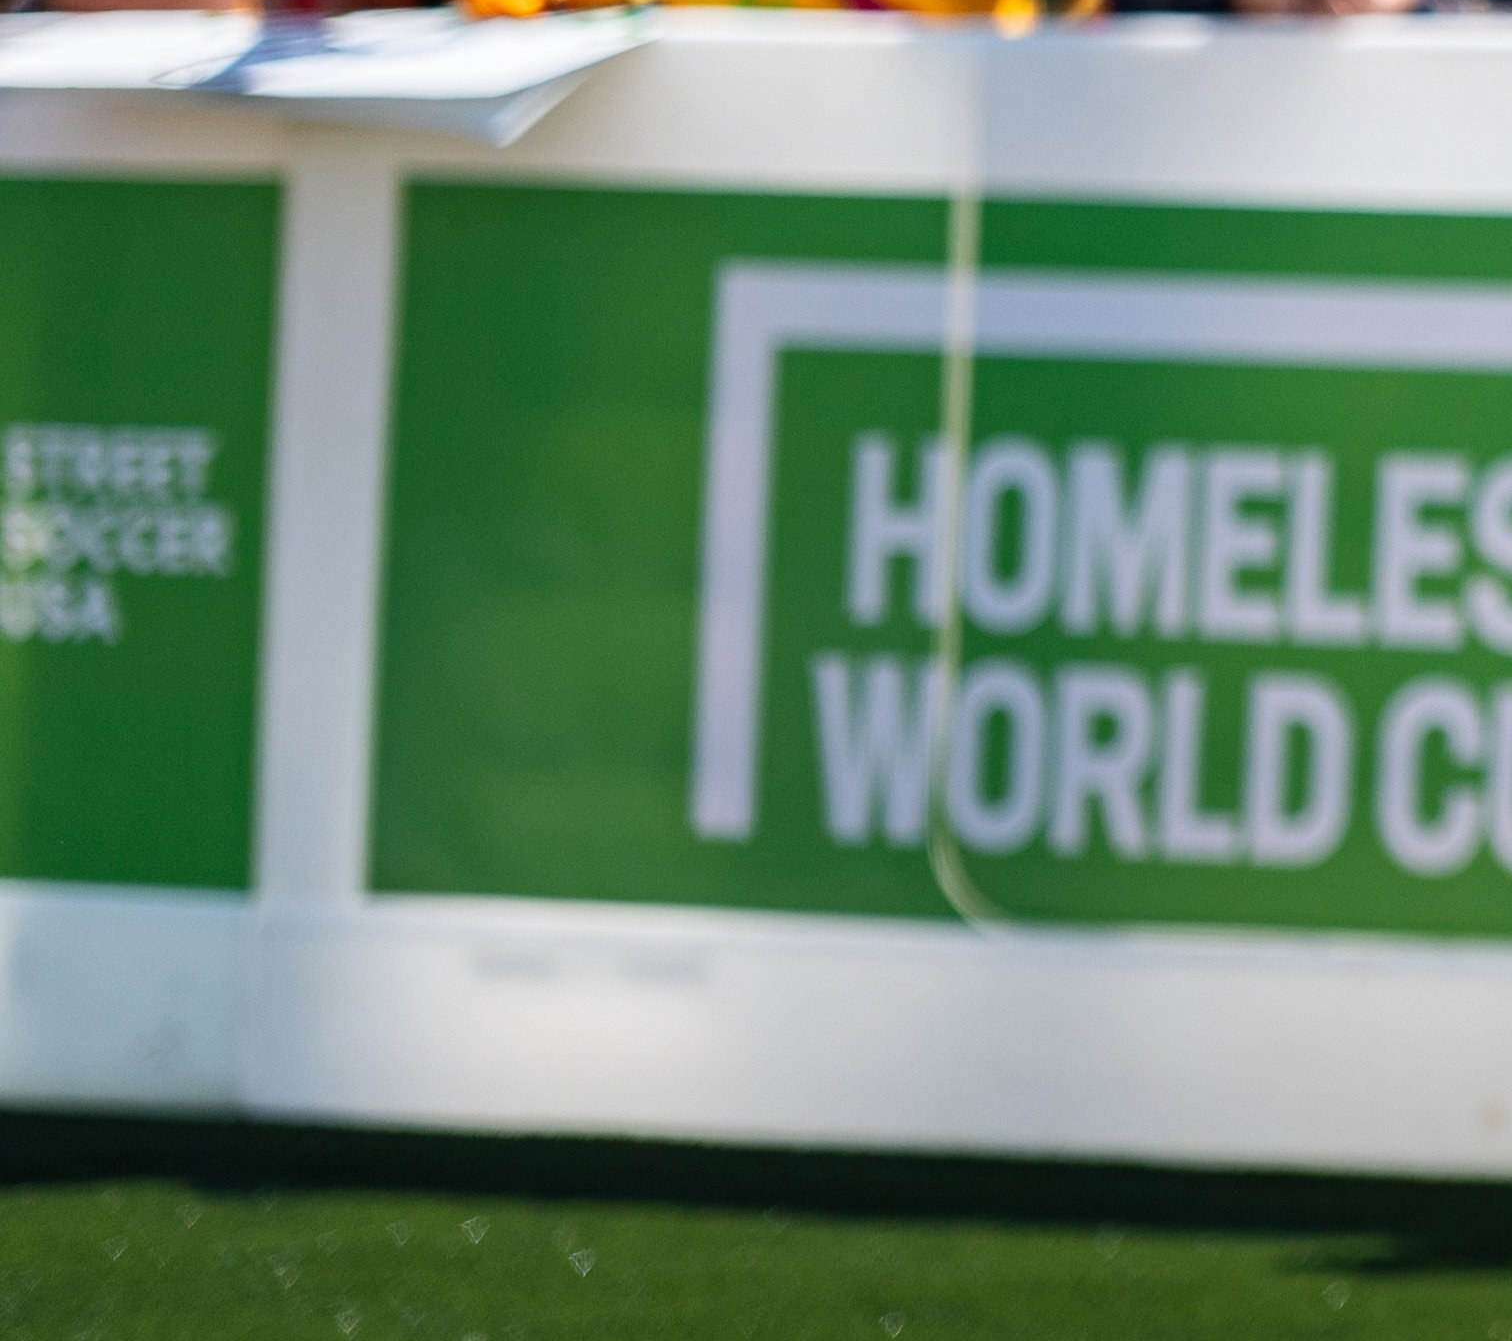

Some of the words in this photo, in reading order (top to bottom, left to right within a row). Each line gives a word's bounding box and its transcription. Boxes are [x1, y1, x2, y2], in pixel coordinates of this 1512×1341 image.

[2, 423, 213, 501] STREET
[0, 505, 236, 575] SOCCER
[0, 579, 121, 645] USA
[812, 653, 1356, 870] WORLD
